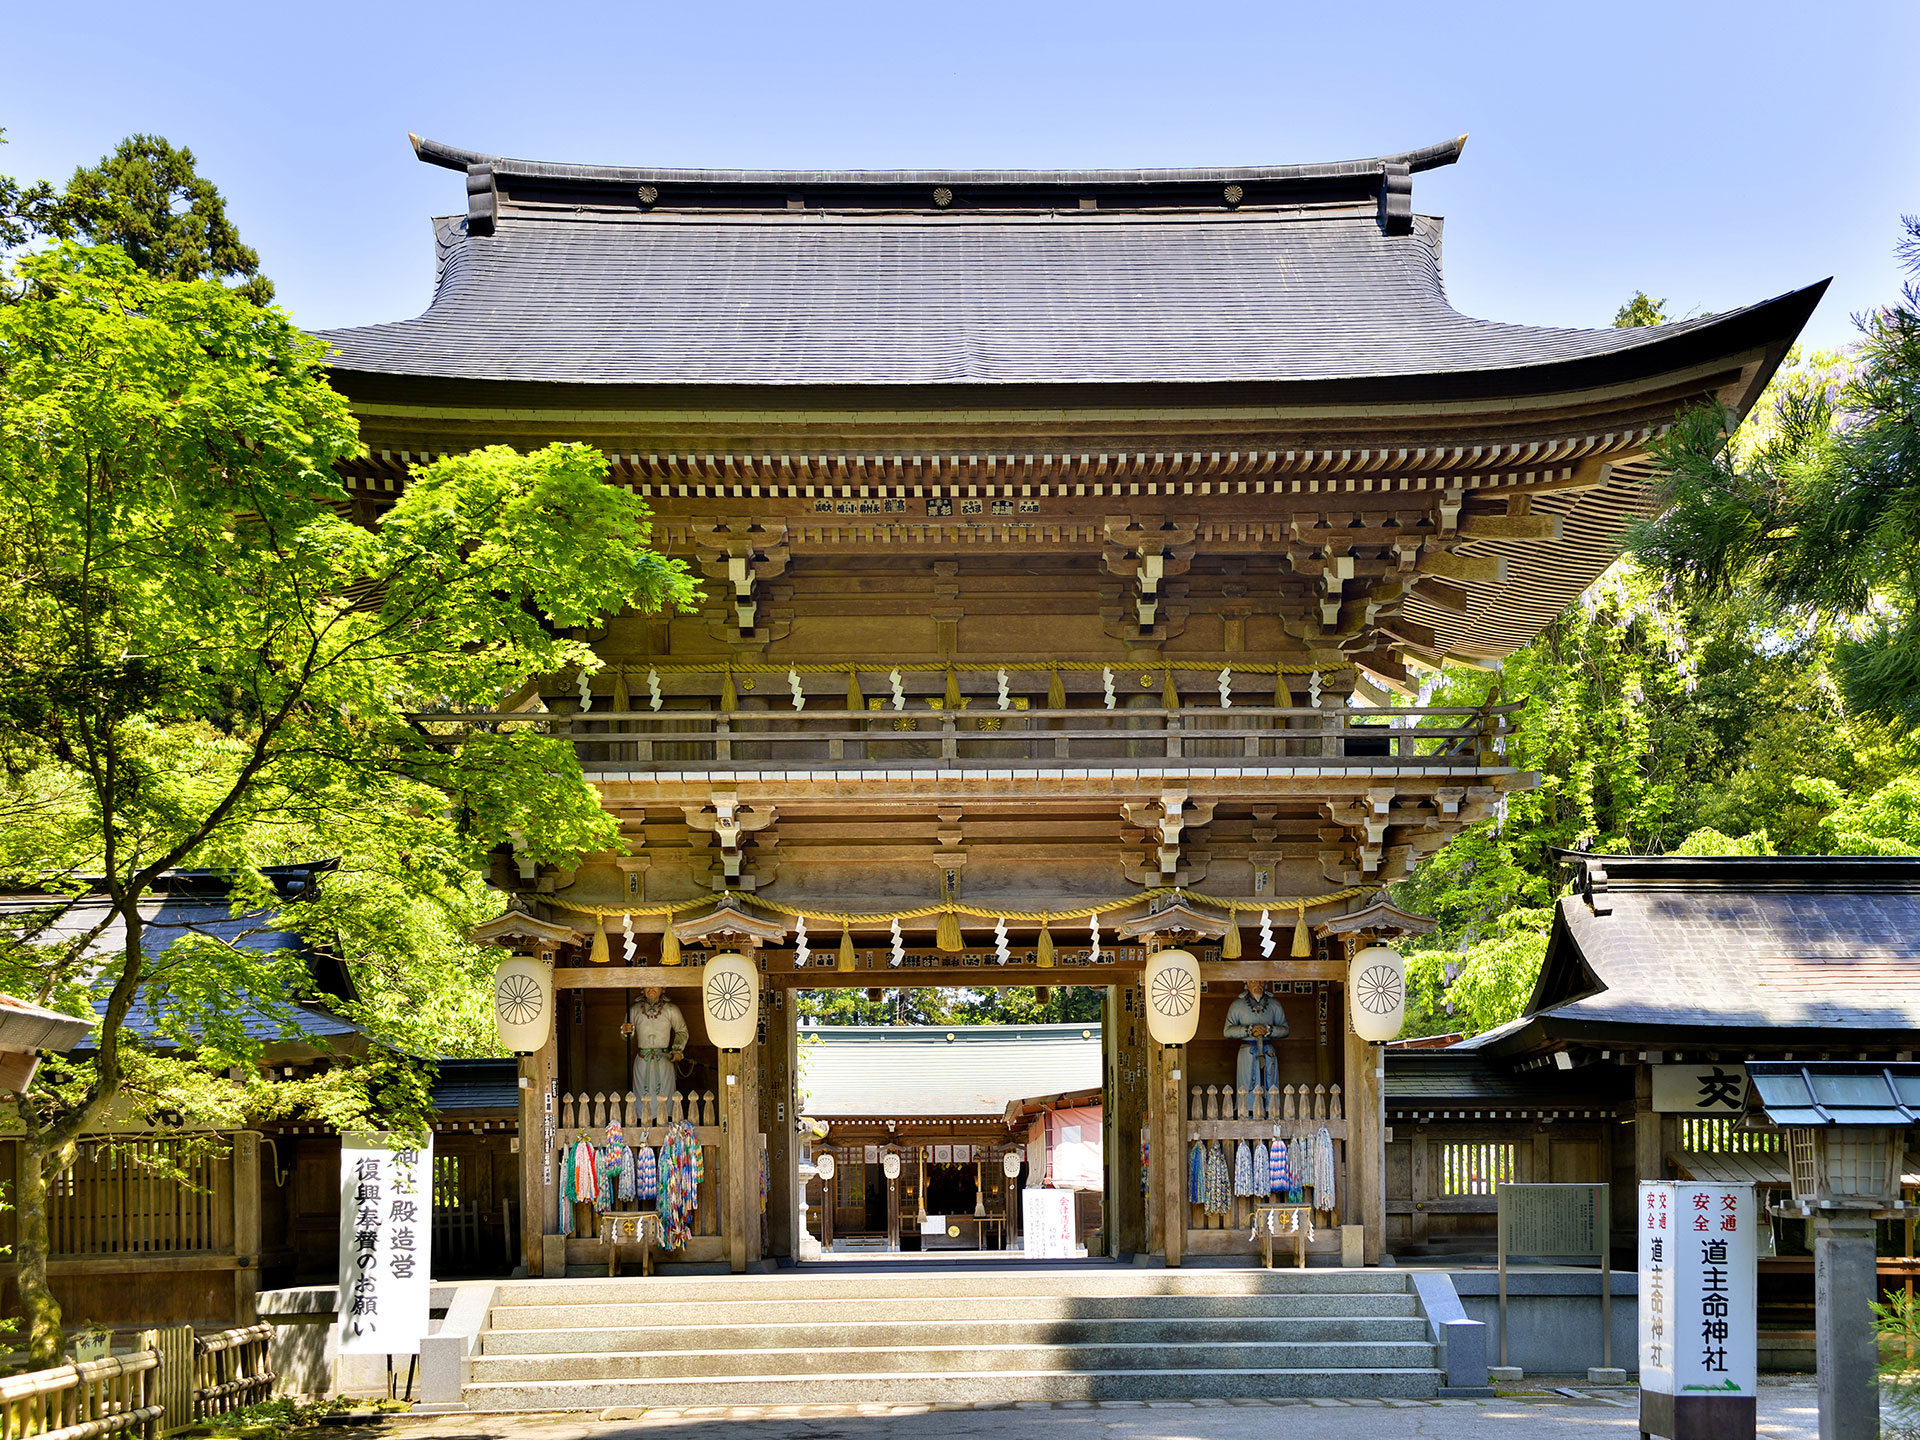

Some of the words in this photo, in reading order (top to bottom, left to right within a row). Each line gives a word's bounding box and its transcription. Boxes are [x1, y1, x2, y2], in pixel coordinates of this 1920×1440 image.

[1696, 1067, 1742, 1110] 交
[1646, 1191, 1656, 1230] 安全
[1658, 1191, 1668, 1230] 交通
[1692, 1192, 1711, 1232] 安全
[1719, 1193, 1738, 1232] 交通
[351, 1157, 382, 1337] 復興奉賛のお願い
[1650, 1236, 1664, 1369] 道主命神社
[1700, 1238, 1729, 1372] 道主命神社
